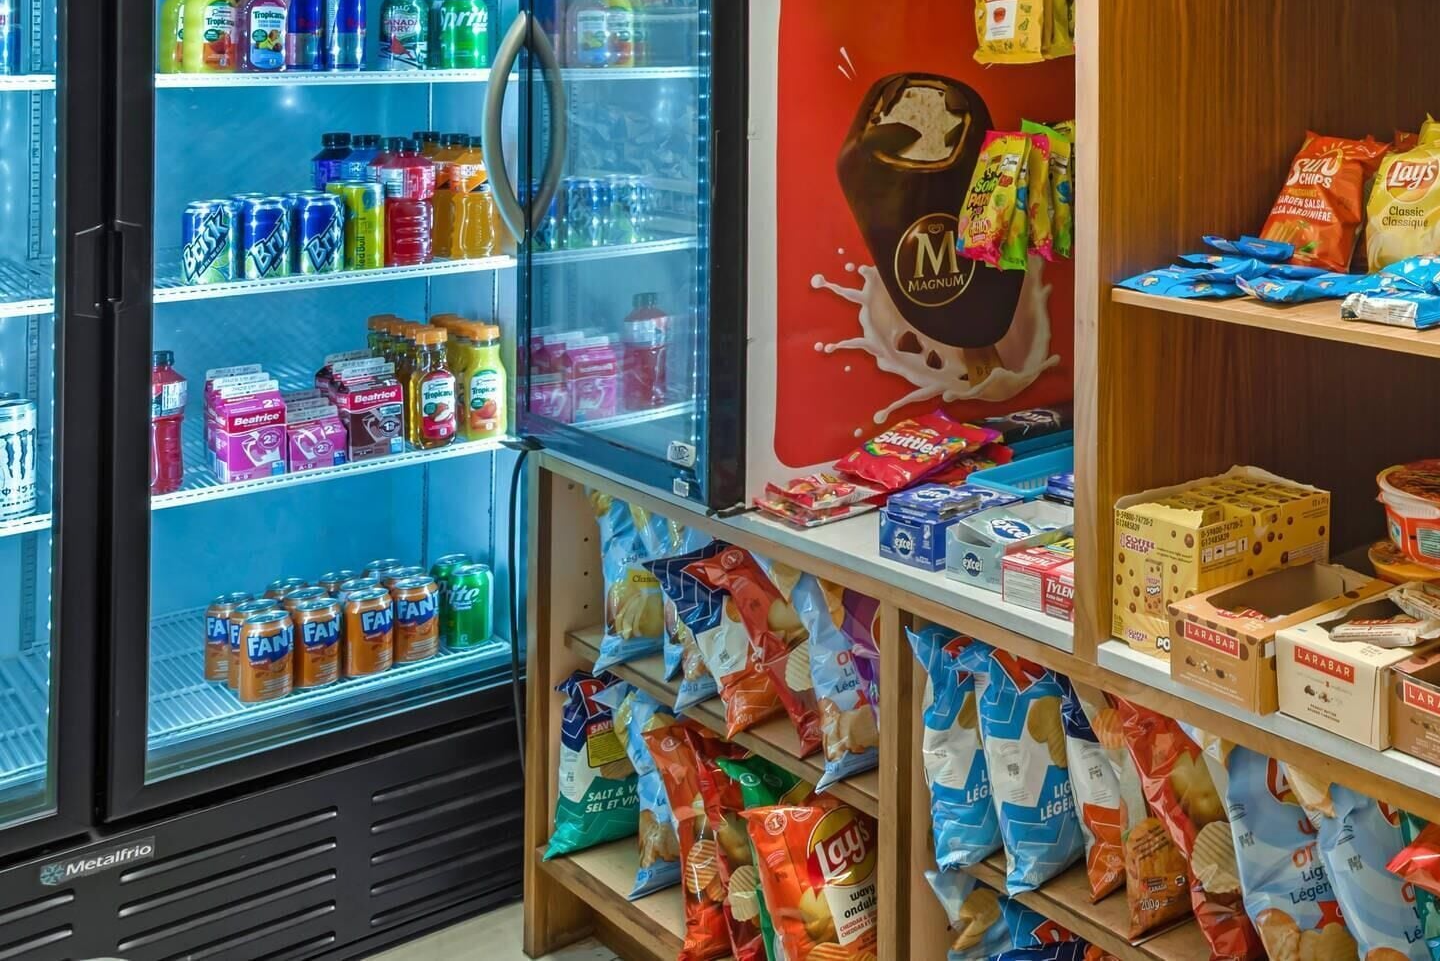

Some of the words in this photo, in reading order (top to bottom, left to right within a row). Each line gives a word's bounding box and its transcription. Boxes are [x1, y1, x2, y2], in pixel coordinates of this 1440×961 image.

[1299, 173, 1332, 189] CHIPS
[1389, 161, 1438, 192] Lay's
[1389, 206, 1424, 218] Classic
[1382, 216, 1429, 229] Classique
[908, 274, 964, 293] MAGNUM
[354, 390, 398, 404] Beatrice
[234, 411, 281, 426] Beatrice
[874, 430, 943, 457] Skittles
[894, 539, 913, 551] excel
[1125, 542, 1149, 554] CRISP
[963, 557, 983, 570] excel
[1187, 626, 1235, 651] LARABAR
[1297, 650, 1351, 678] LARABAR
[586, 790, 613, 804] SALT
[615, 788, 625, 801] &
[585, 801, 604, 814] SEL
[605, 800, 620, 812] ET
[65, 842, 152, 877] Metalfrio
